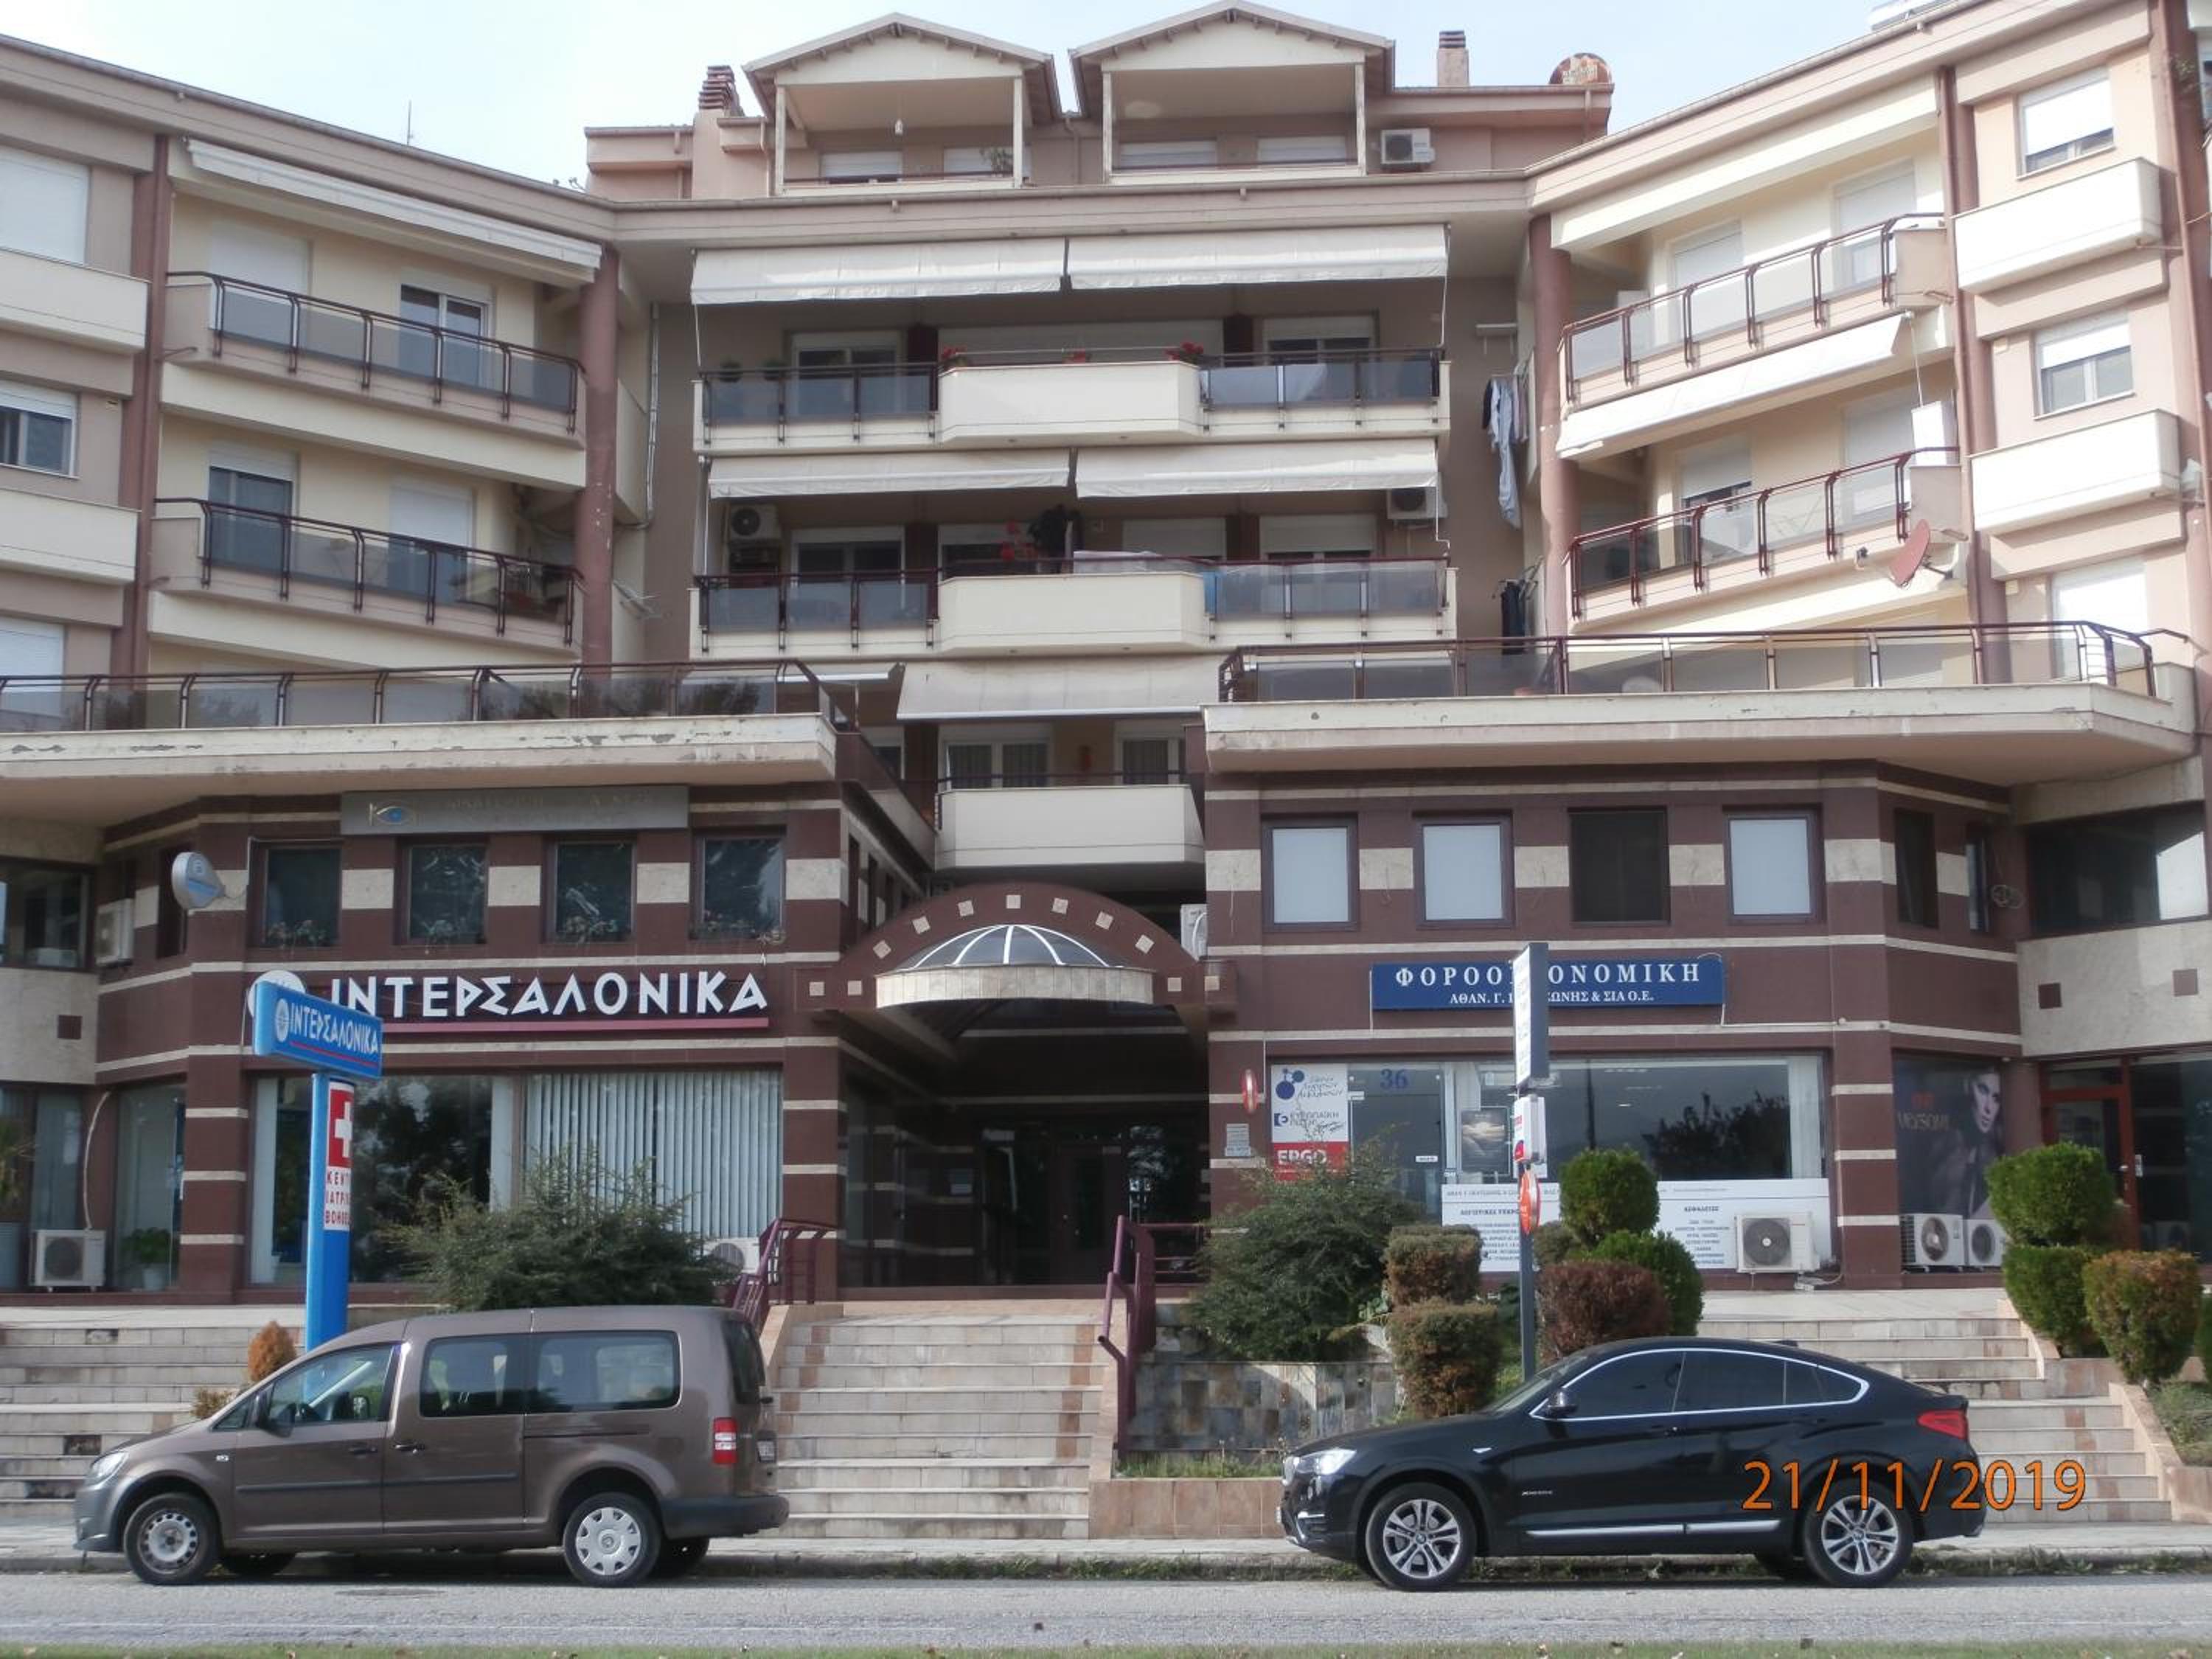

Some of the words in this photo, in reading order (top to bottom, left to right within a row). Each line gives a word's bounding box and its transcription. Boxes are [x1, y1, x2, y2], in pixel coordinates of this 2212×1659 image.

[1395, 963, 1700, 987] ΦΟΡΟΟΟΝΟΜΙΚΗ
[331, 970, 768, 1018] ΙΝΤΕΡΣΑΛΟΝΙΚΑ
[1450, 992, 1490, 1004] ΑΘΑΝ.
[1590, 991, 1601, 1002] &
[1603, 990, 1626, 1002] ΣΙΑ
[289, 1001, 379, 1055] ΙΝΤΕΡΣΑΛΟΝΙΚΑ
[1380, 1068, 1409, 1089] 36
